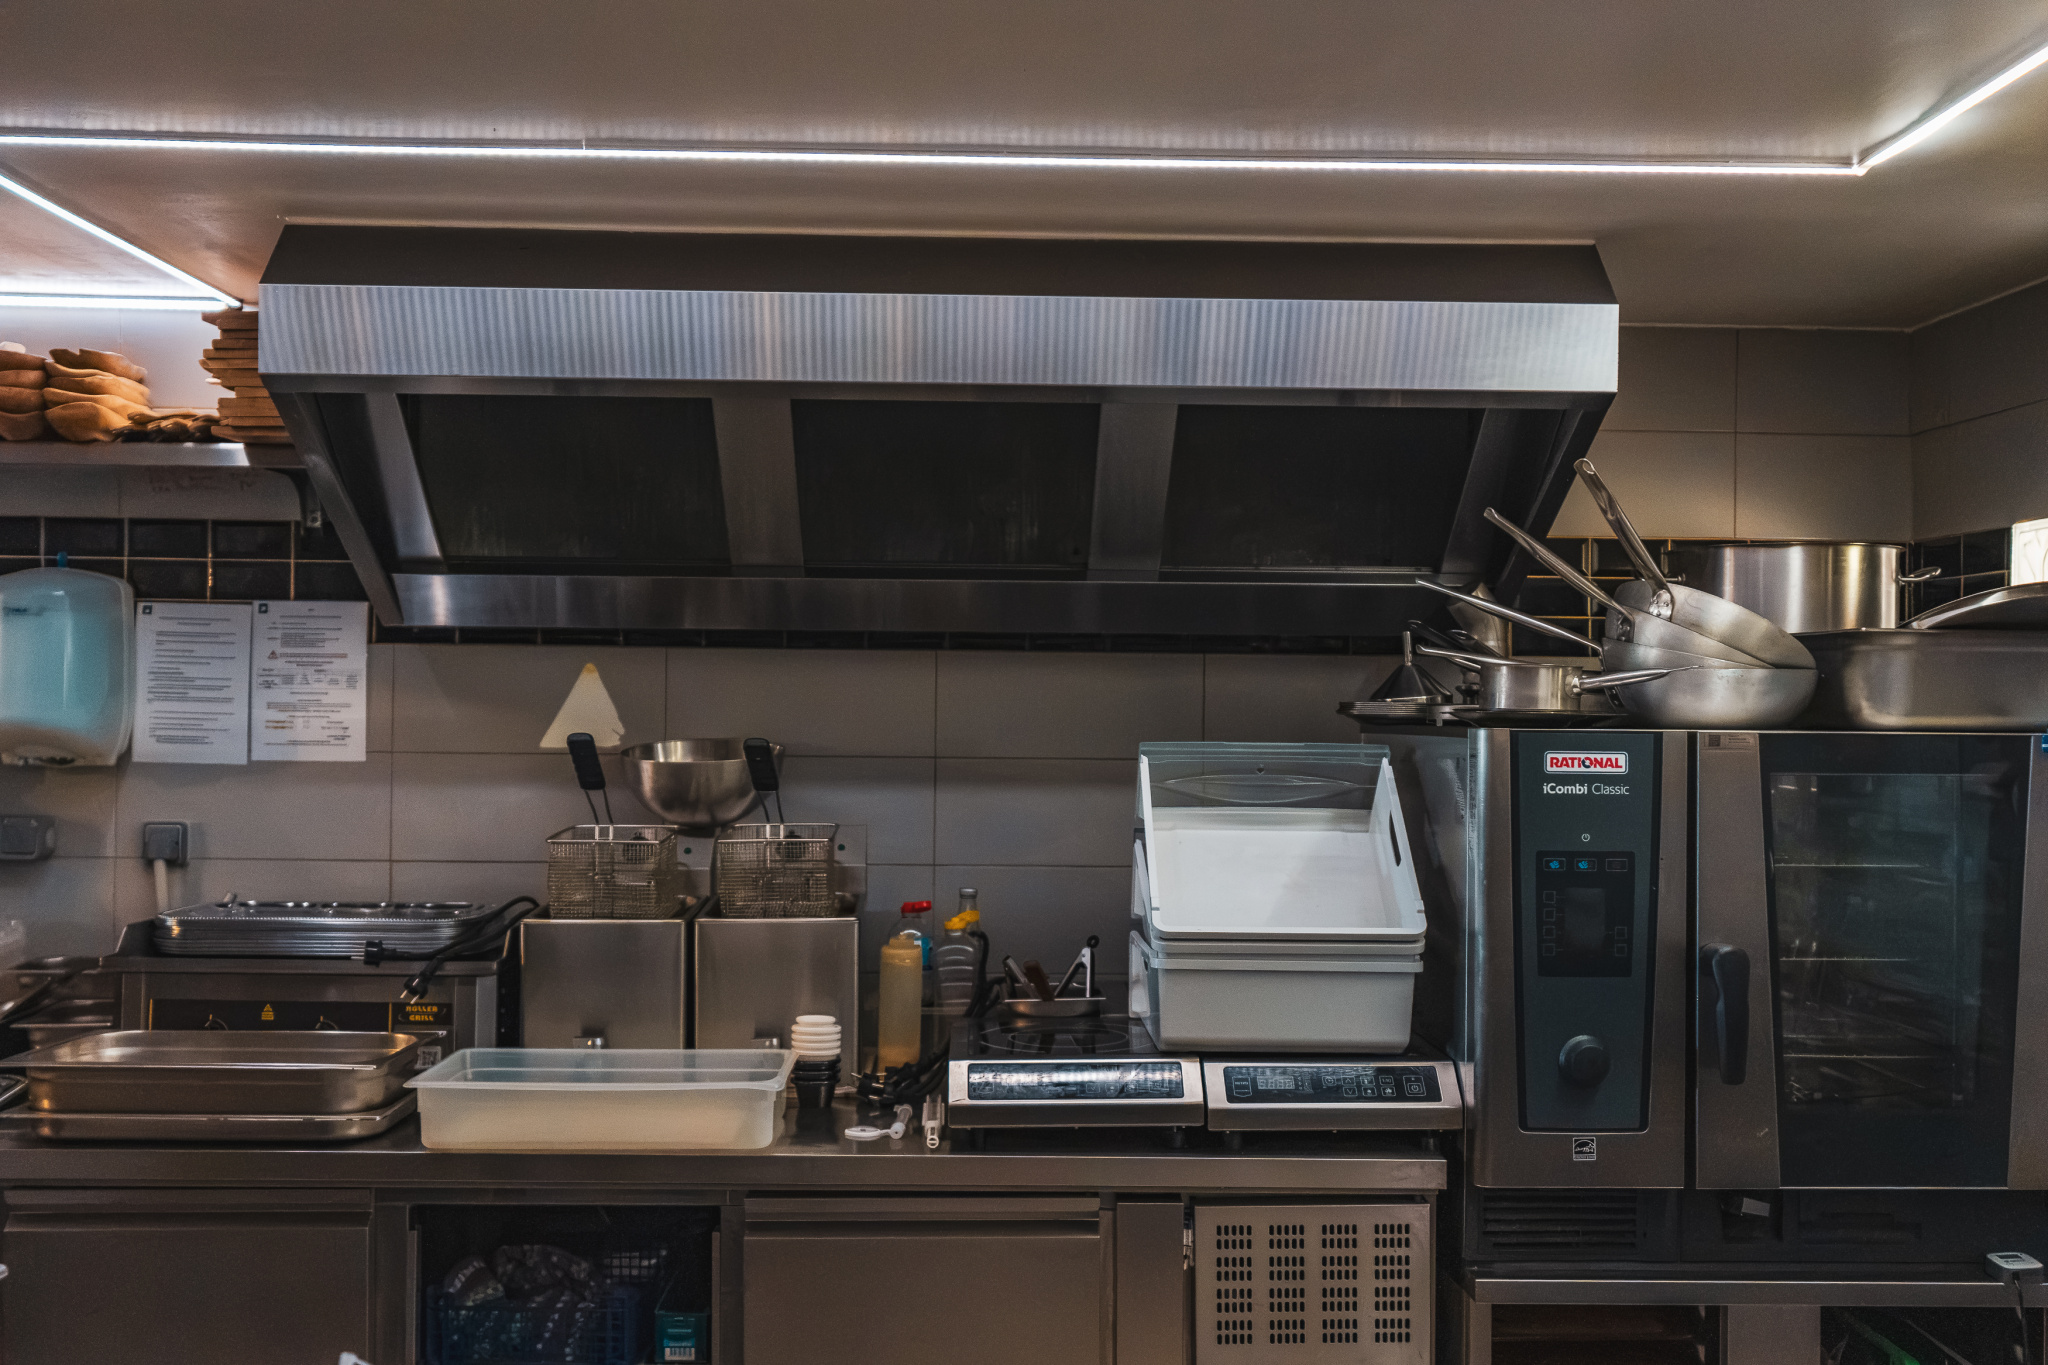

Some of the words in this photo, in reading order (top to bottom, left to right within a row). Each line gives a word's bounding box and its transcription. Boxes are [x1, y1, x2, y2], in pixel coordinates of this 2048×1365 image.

[1549, 757, 1622, 768] RATIONAL
[1543, 783, 1588, 794] iCombi
[1591, 783, 1630, 795] Classic
